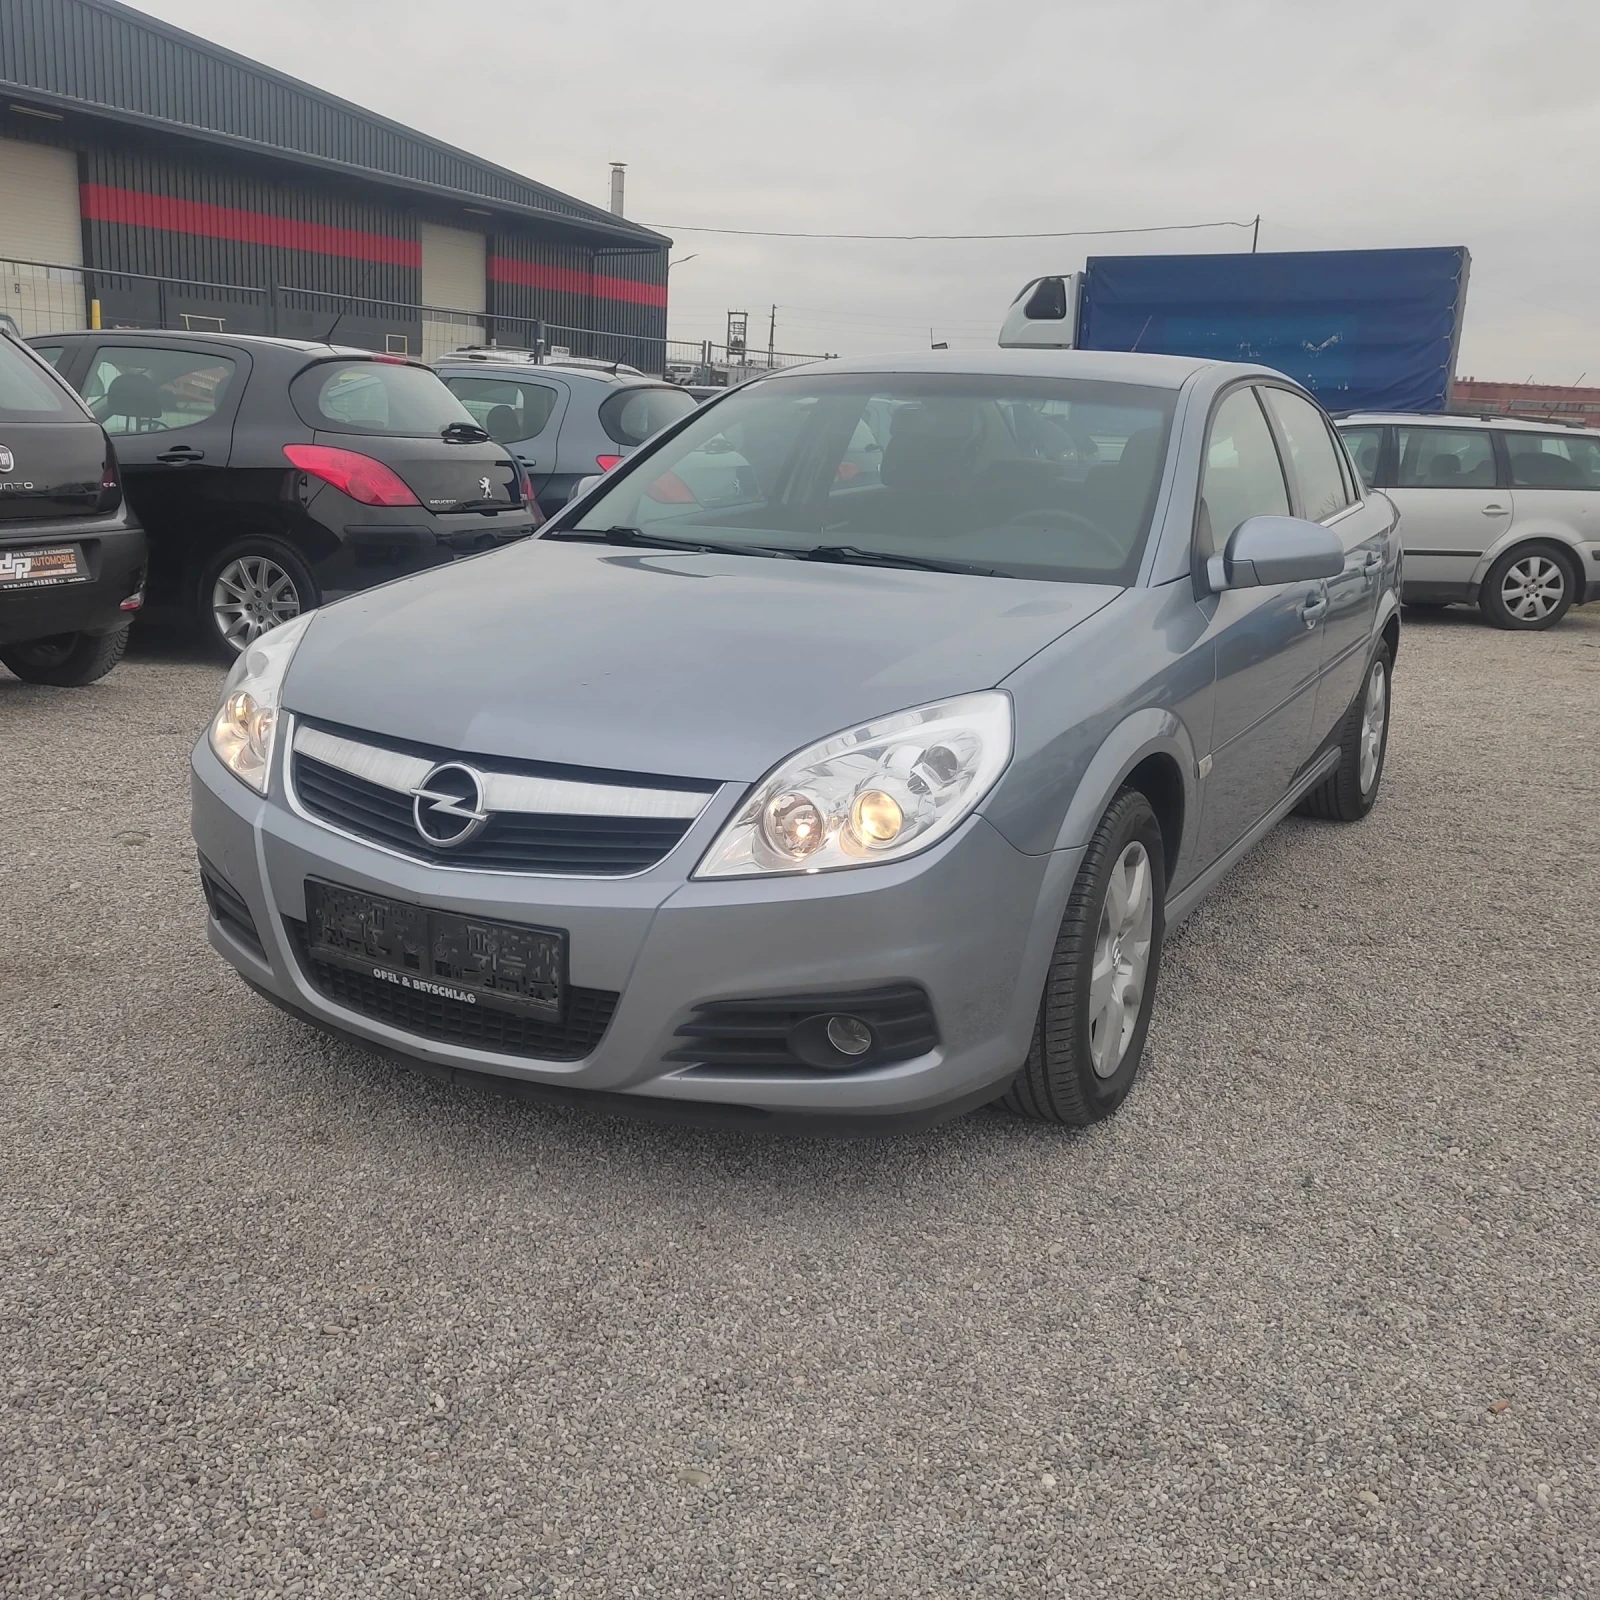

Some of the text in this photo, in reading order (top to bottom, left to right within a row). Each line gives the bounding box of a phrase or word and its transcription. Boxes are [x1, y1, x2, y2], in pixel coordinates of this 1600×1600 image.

[32, 554, 76, 567] AUTOMOBILE
[373, 968, 477, 1004] OPEL & BEYSCHLAG
